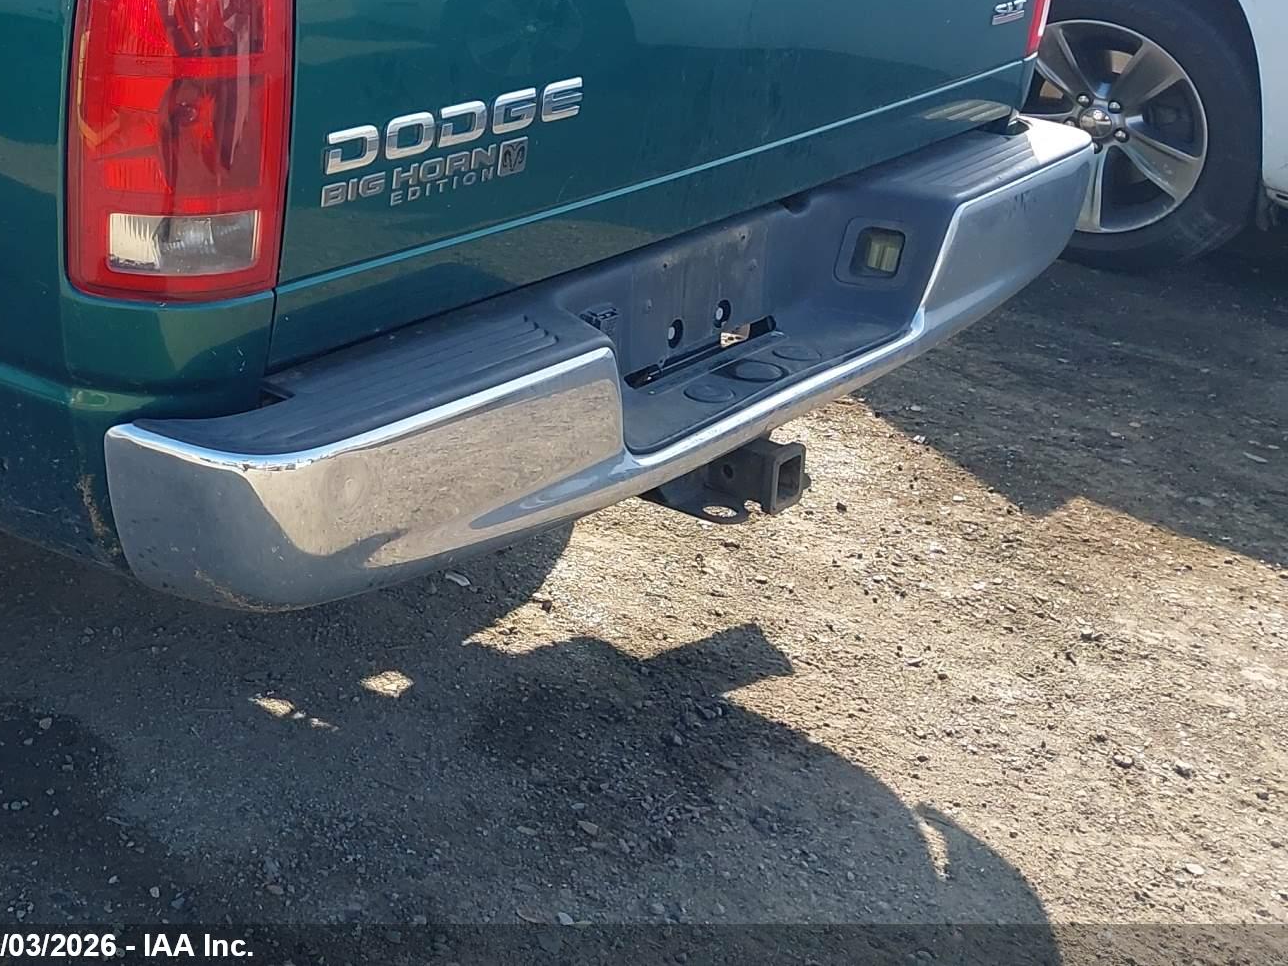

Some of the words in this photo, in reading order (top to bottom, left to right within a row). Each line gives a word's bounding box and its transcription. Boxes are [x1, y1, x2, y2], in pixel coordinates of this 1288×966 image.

[325, 76, 583, 175] DODGE
[321, 171, 386, 208] BIG
[392, 144, 497, 190] HORN
[390, 167, 495, 207] EDITION
